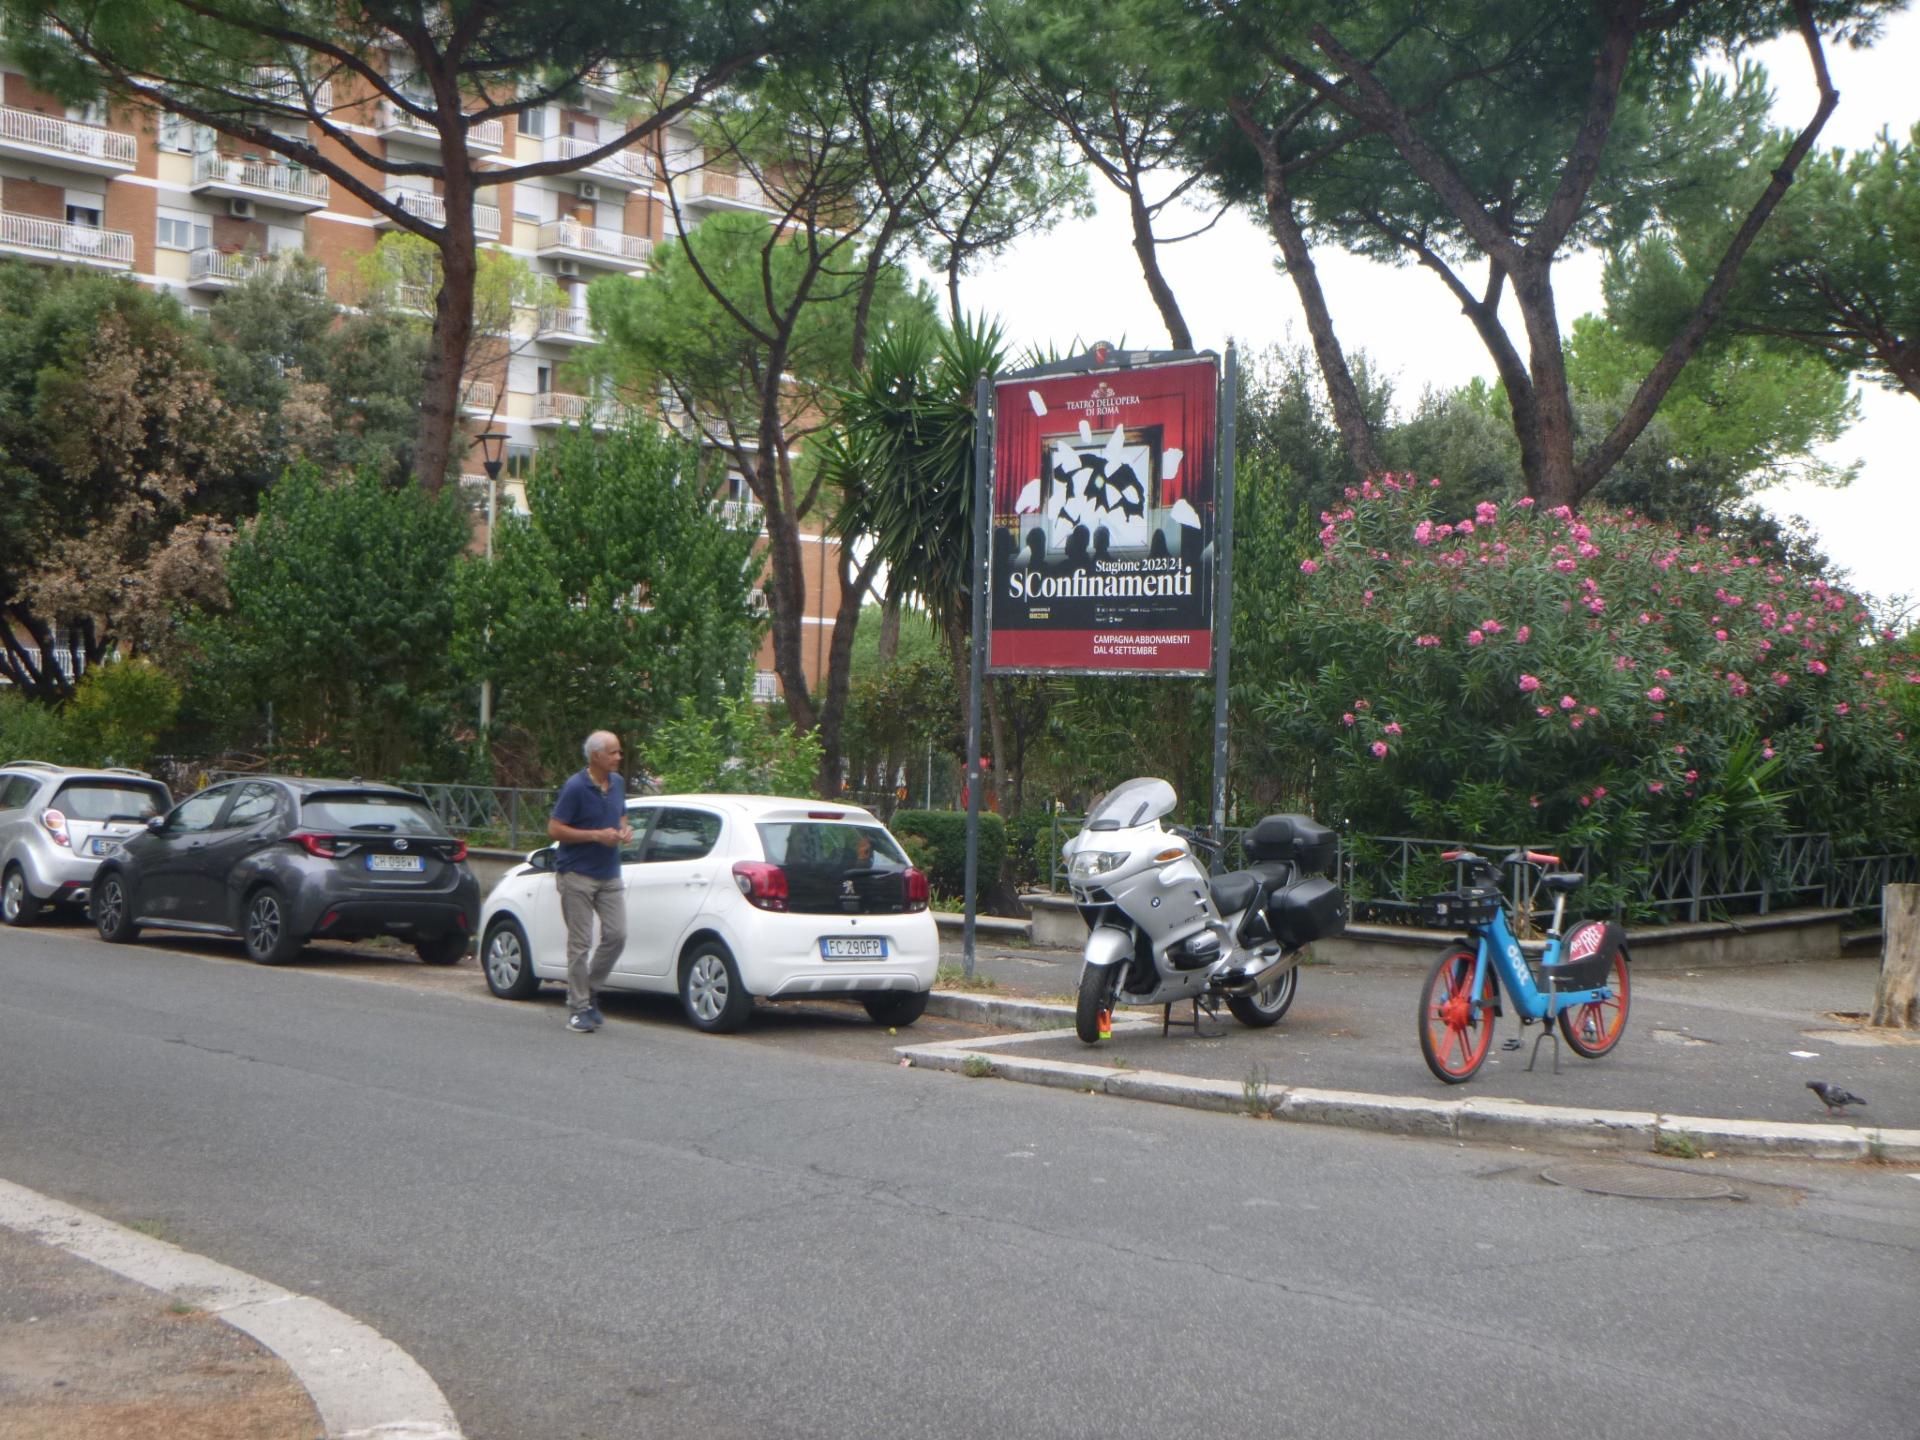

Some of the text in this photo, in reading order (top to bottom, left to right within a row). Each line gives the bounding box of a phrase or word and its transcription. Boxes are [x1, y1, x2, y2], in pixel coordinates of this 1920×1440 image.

[1066, 396, 1140, 411] TEATRO DELL'OPERA
[1086, 406, 1120, 417] DI ROMA
[1096, 559, 1140, 574] Stagione
[1093, 634, 1190, 644] CAMPAGNA ABBONAMENTI
[1093, 645, 1108, 655] DAL
[1115, 646, 1158, 655] SETTEMBRE
[829, 940, 844, 954] FC
